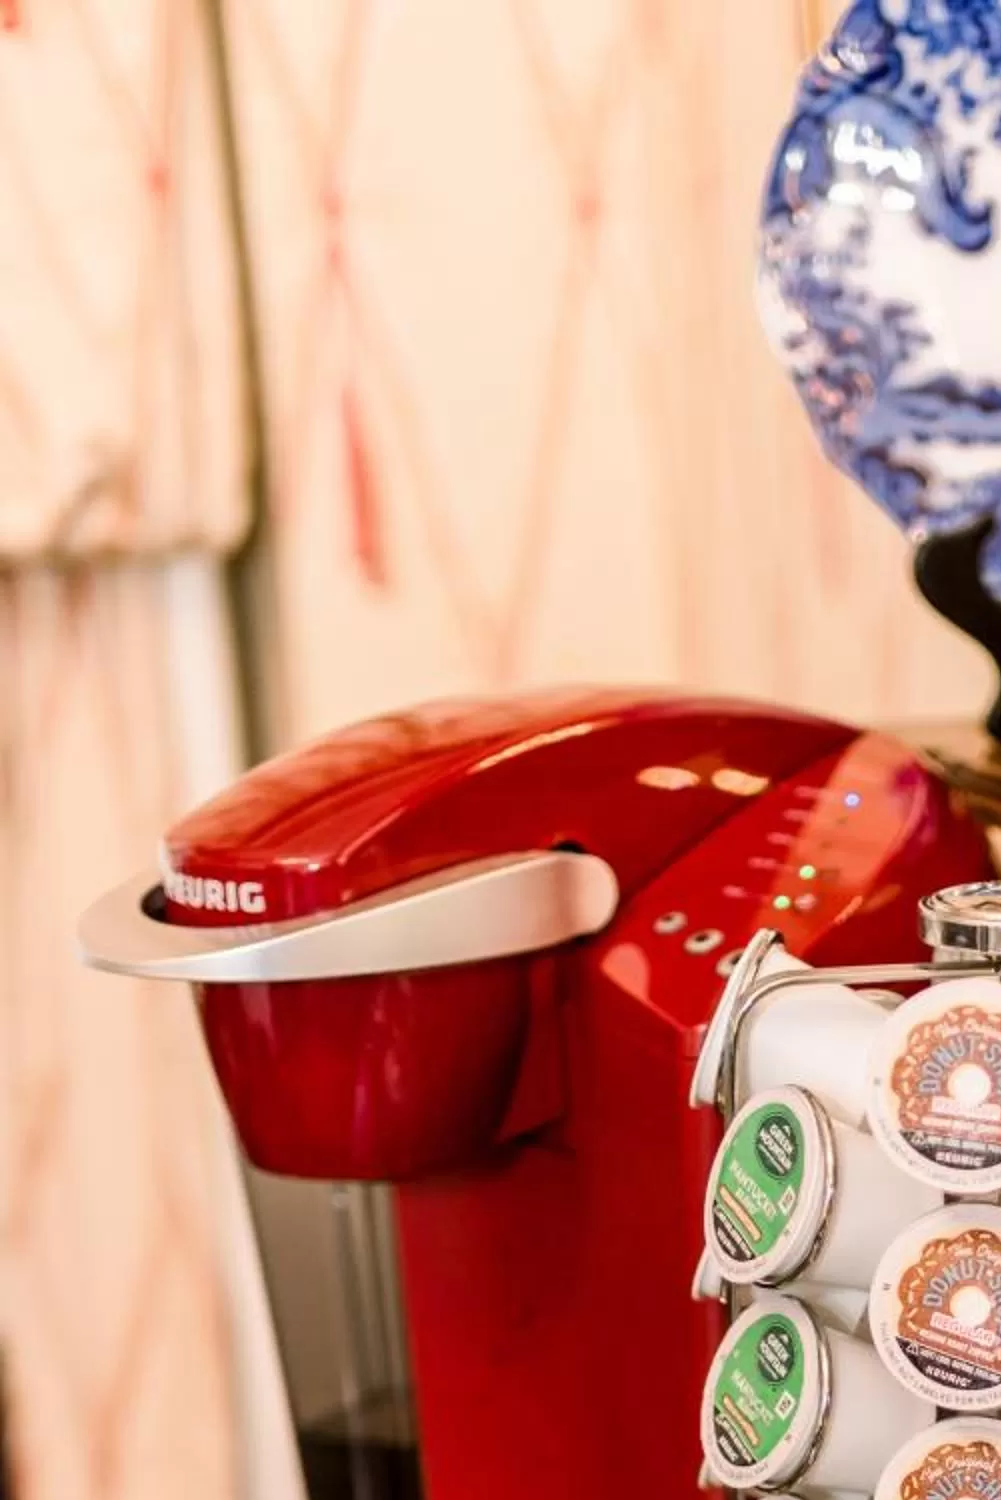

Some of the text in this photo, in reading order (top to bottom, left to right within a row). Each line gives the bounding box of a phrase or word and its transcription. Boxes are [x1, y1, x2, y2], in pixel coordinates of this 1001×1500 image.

[919, 1033, 982, 1095] DONUT
[923, 1257, 991, 1308] DONUT
[924, 1364, 971, 1388] KEURIG
